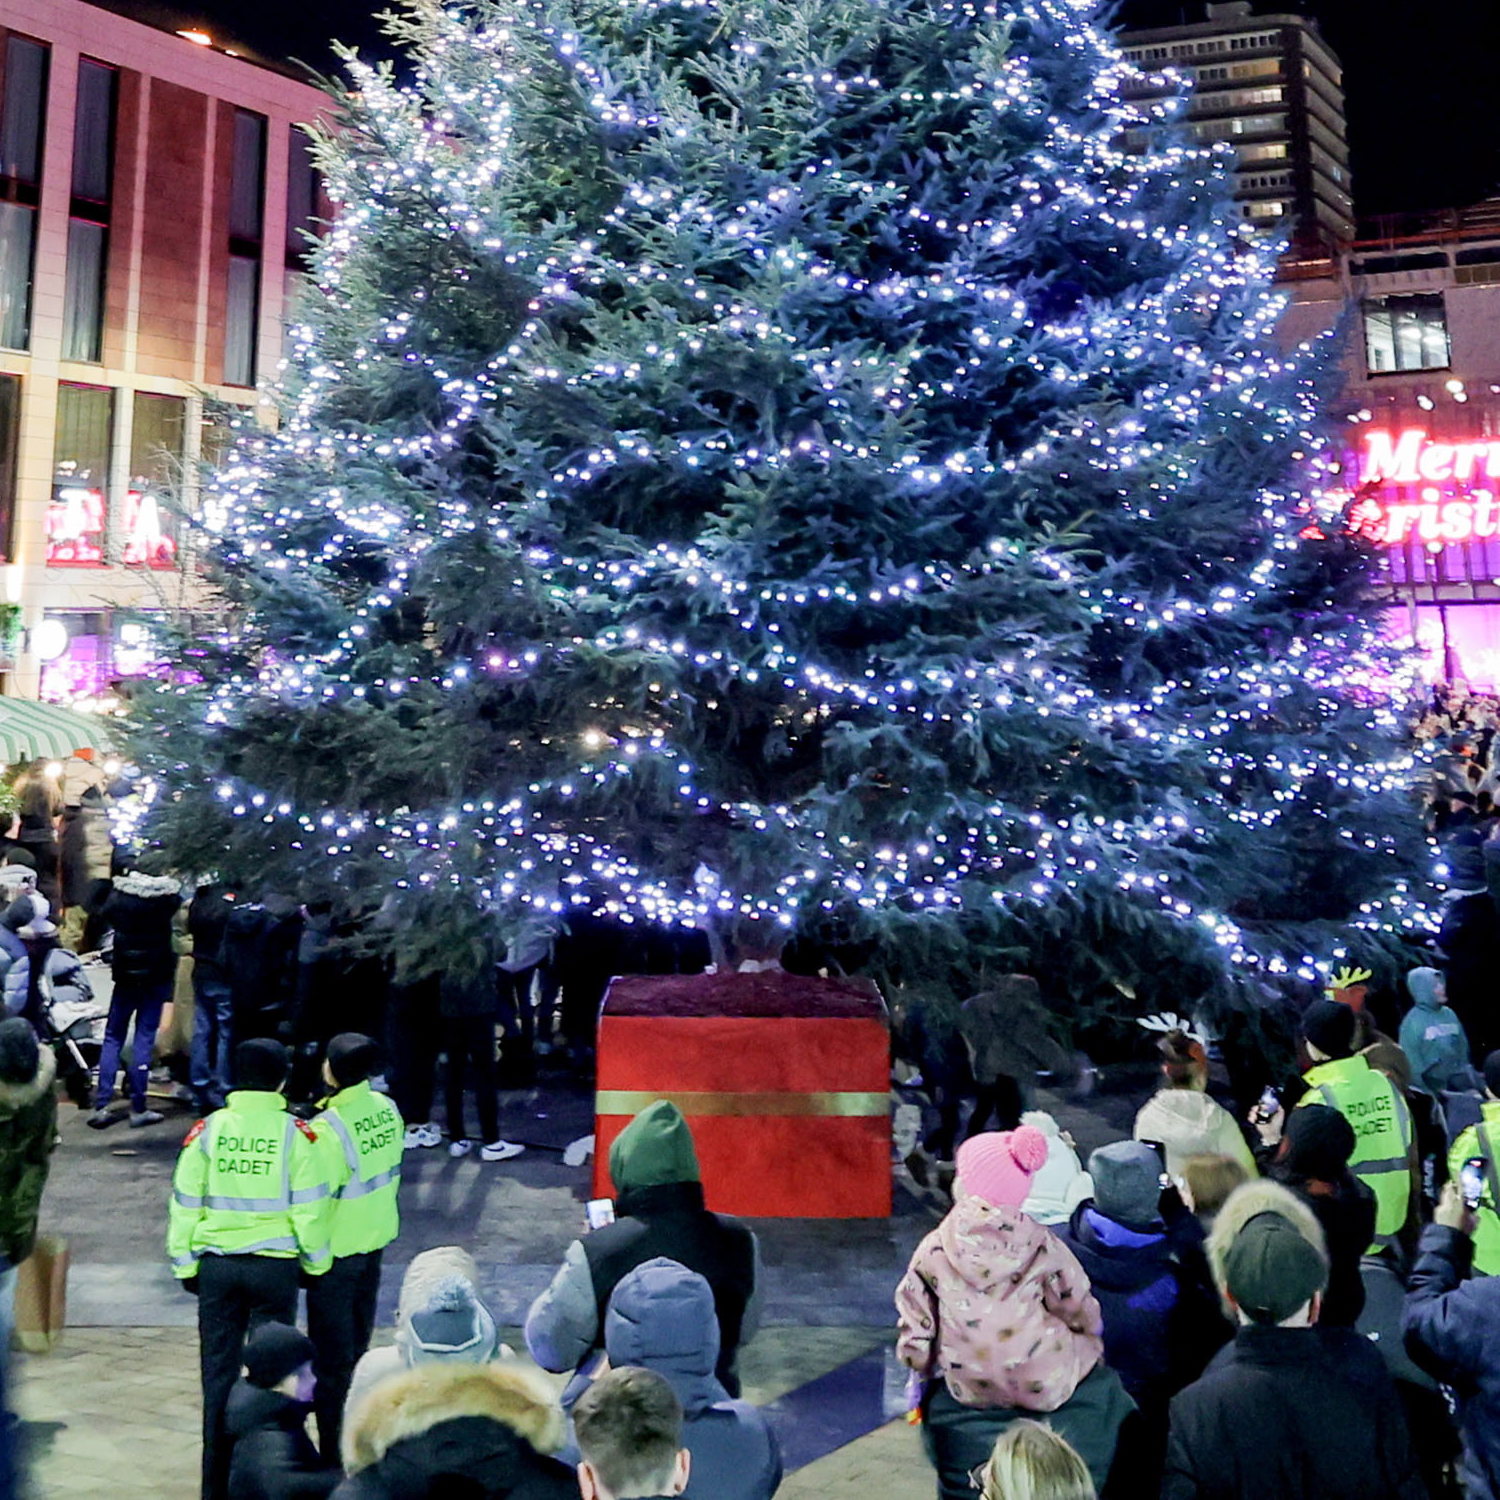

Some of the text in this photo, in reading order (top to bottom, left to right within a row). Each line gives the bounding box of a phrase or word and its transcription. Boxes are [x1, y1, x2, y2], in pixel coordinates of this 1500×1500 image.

[1346, 1095, 1392, 1117] POLICE
[353, 1107, 395, 1136] POLICE
[217, 1135, 278, 1154] POLICE
[360, 1127, 397, 1156] CADET
[217, 1157, 274, 1176] CADET
